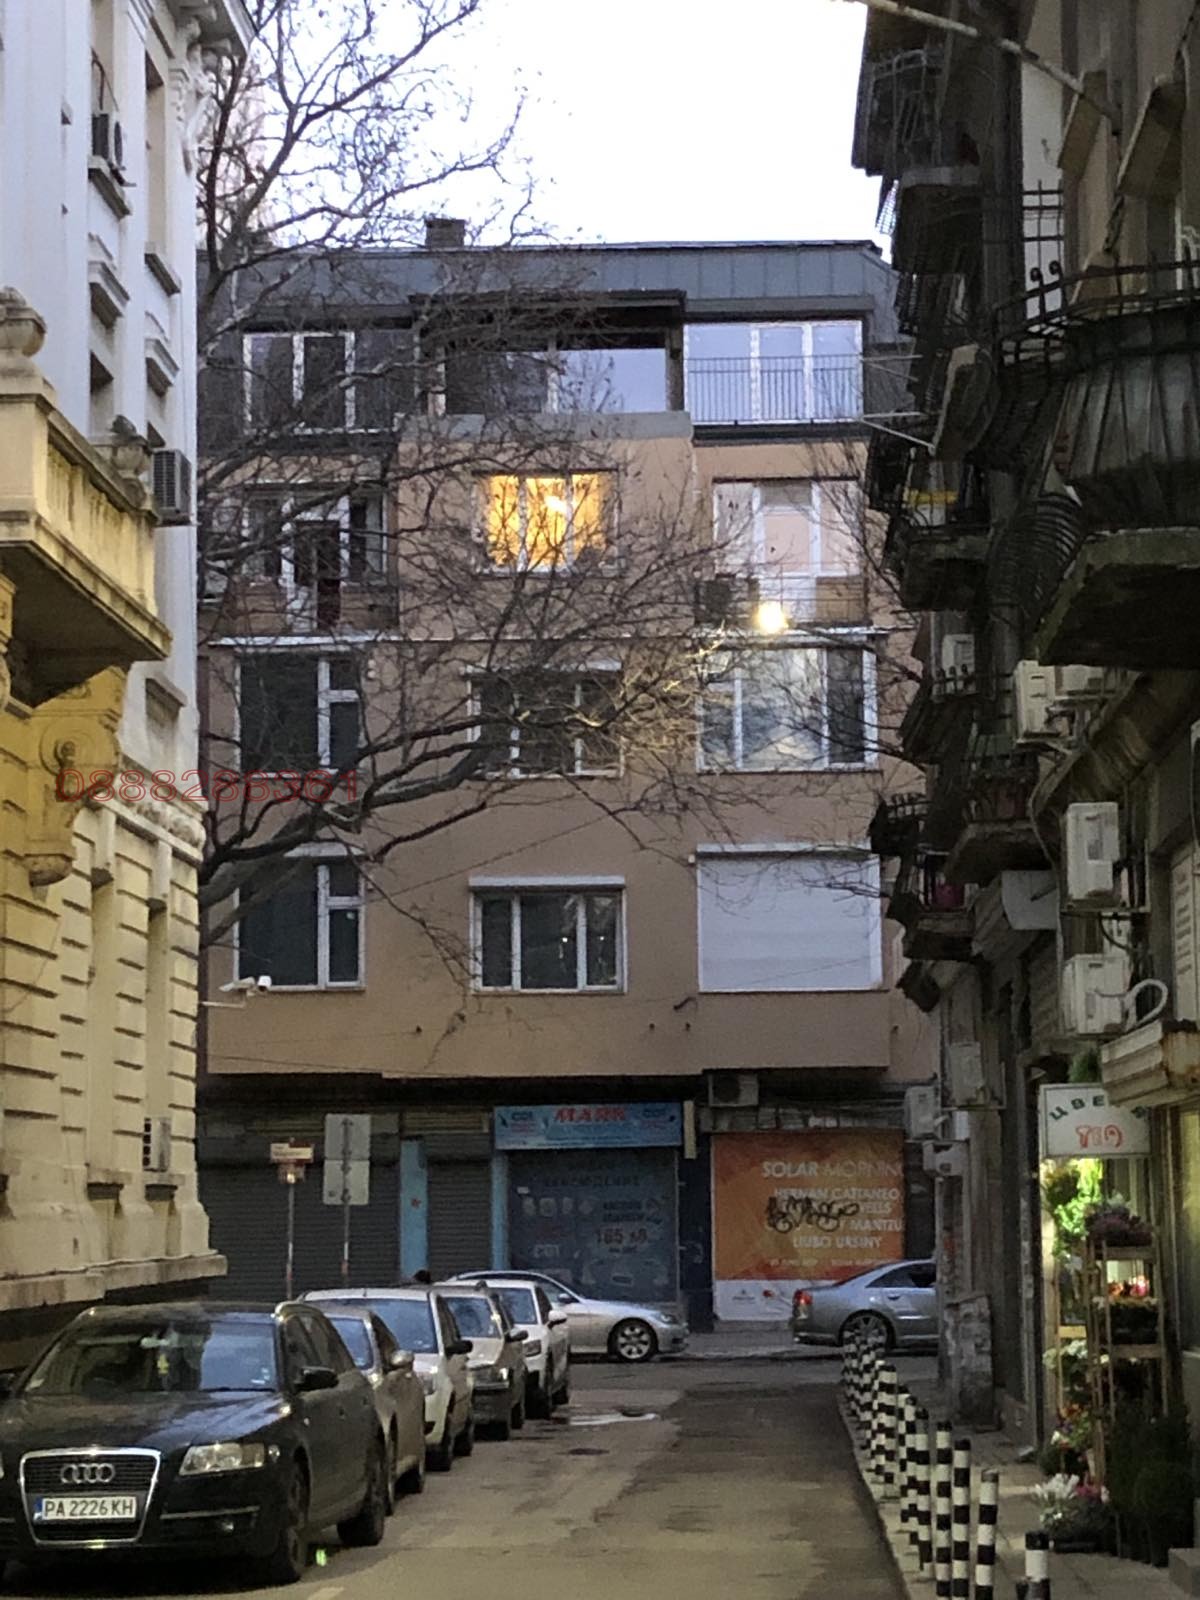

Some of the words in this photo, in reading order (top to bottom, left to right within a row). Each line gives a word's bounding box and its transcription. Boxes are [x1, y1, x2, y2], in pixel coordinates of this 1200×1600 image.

[762, 1161, 818, 1178] SOLAR
[44, 1502, 66, 1517] PA
[69, 1500, 108, 1517] 2226
[111, 1499, 134, 1516] KH
